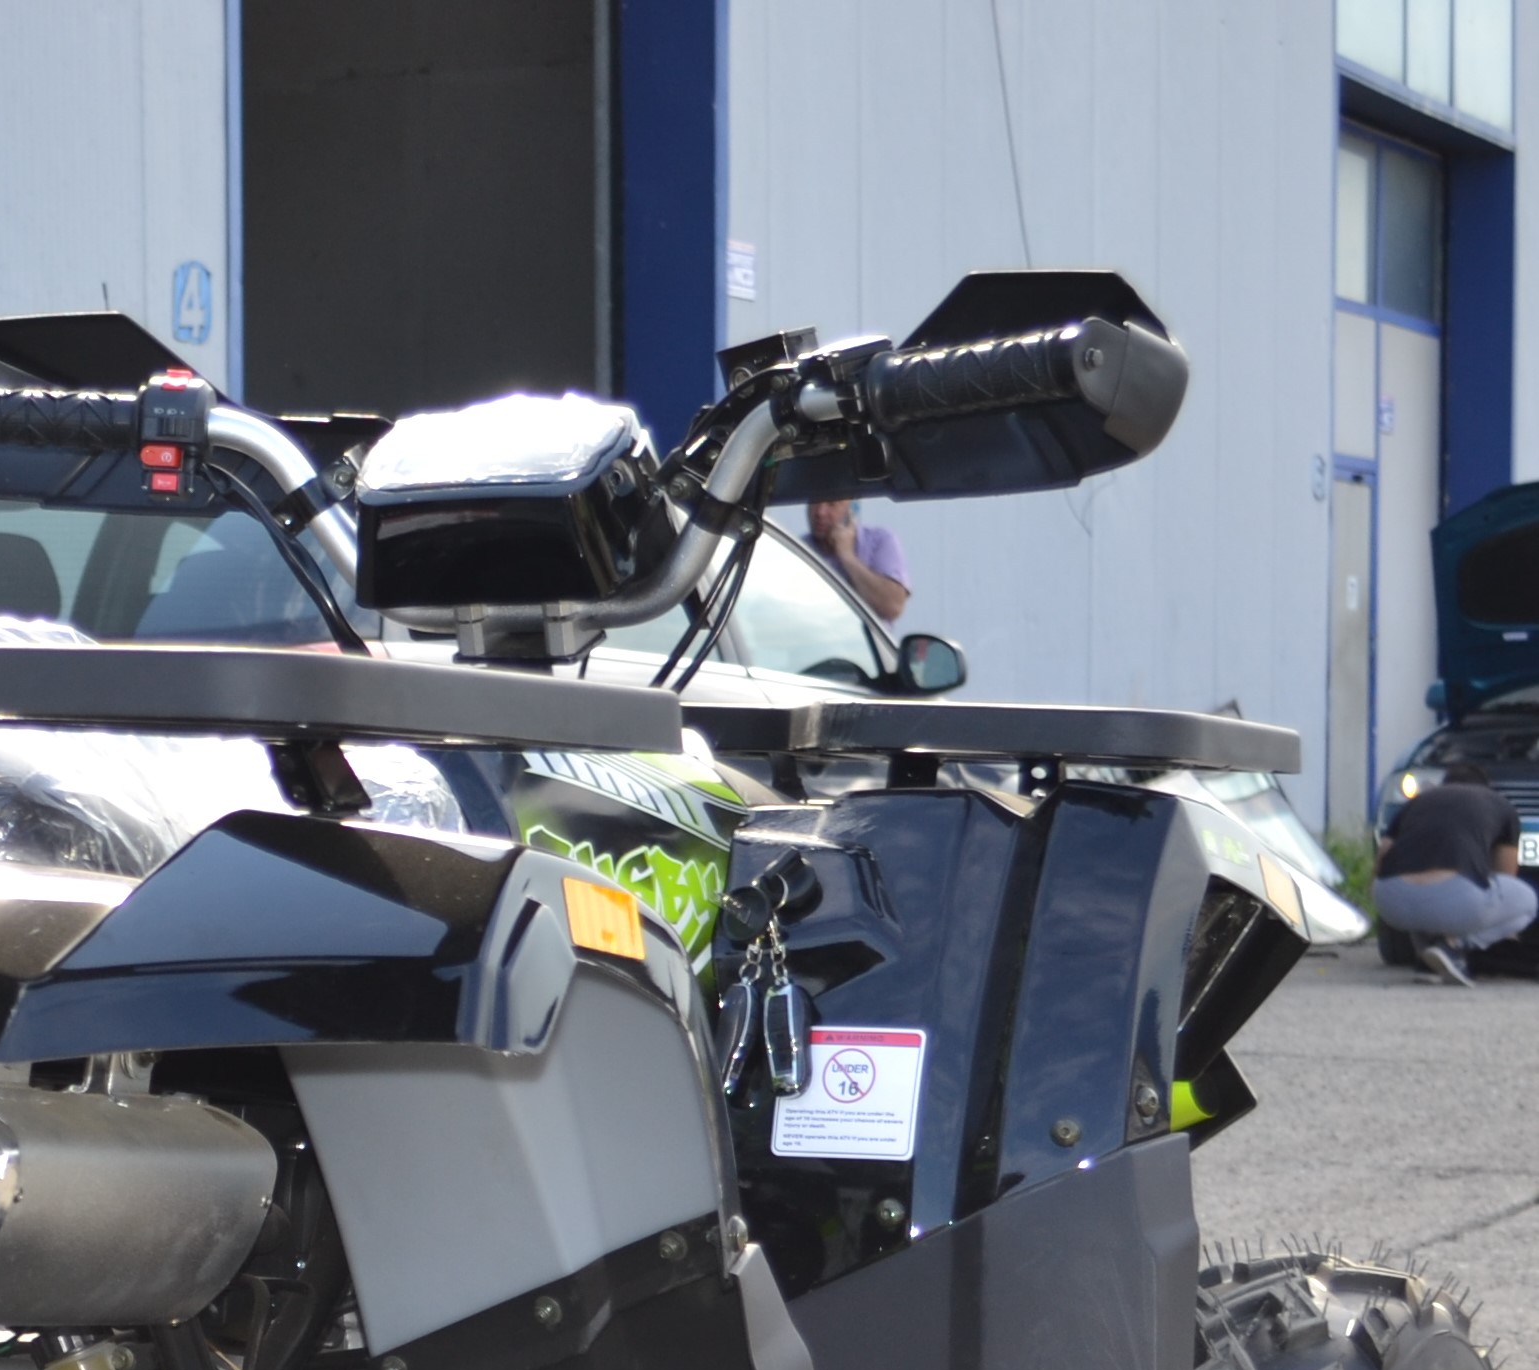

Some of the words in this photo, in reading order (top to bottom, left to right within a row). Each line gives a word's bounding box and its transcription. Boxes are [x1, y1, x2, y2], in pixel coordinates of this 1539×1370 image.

[178, 264, 206, 340] 4
[832, 1064, 869, 1074] UNDER
[838, 1081, 861, 1096] 16
